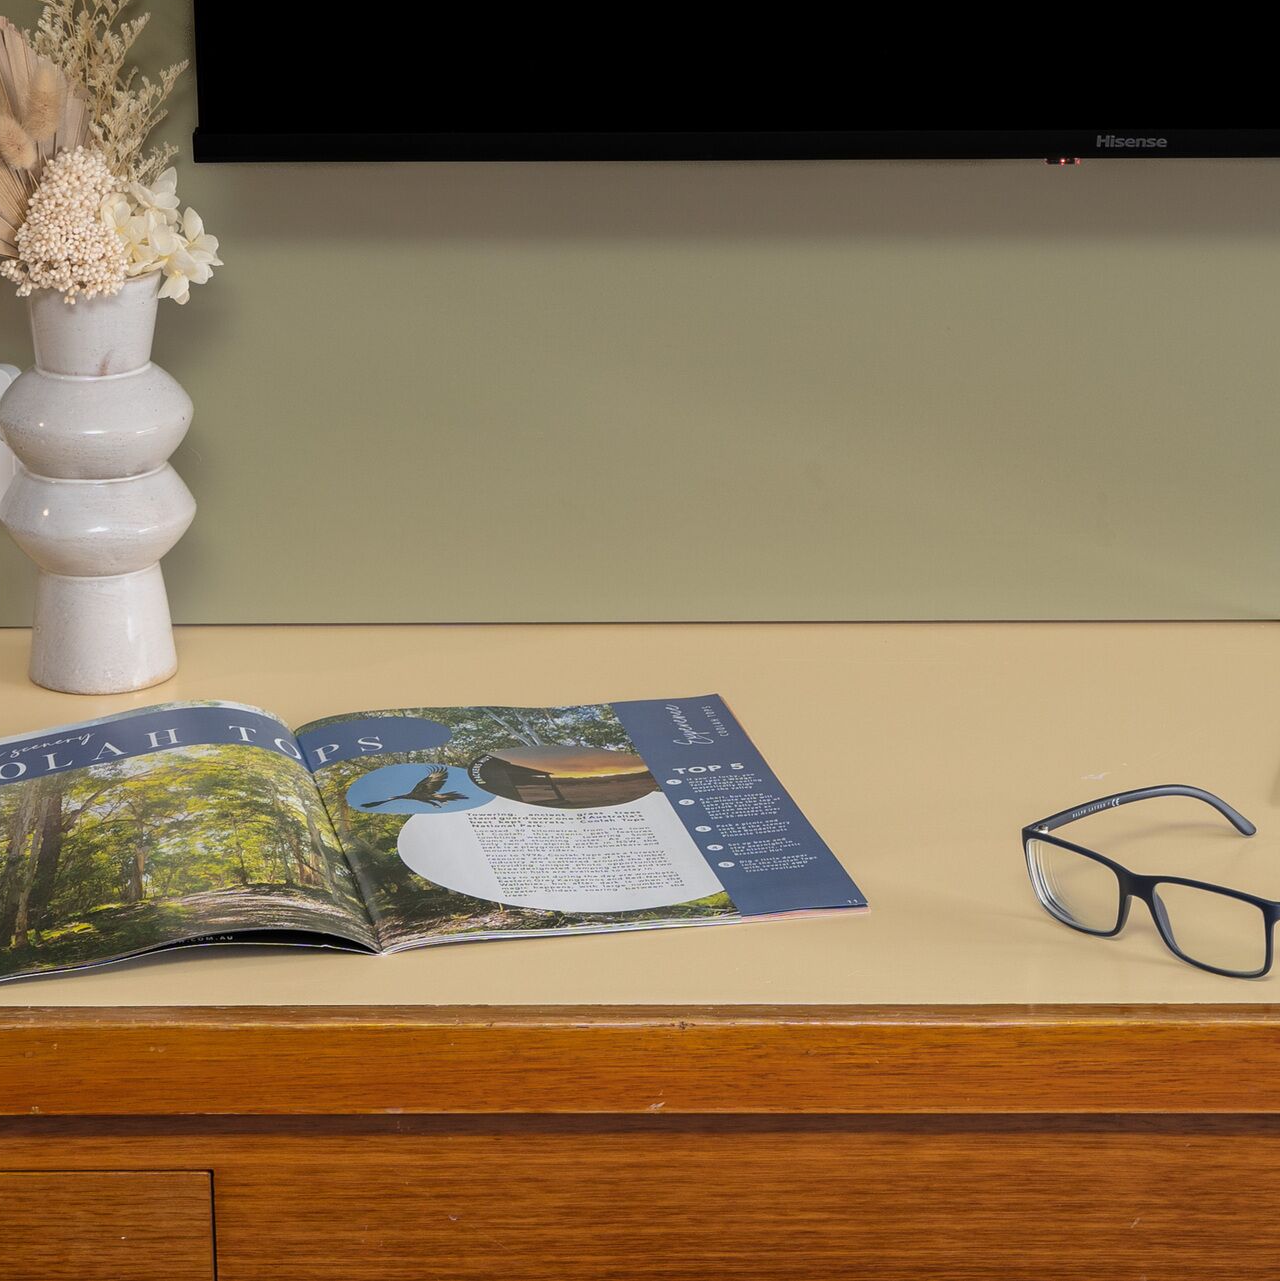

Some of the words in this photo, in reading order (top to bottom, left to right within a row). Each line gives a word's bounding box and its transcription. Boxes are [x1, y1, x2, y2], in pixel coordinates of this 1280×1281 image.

[1096, 135, 1168, 148] Hisense
[10, 732, 95, 759] scenery
[228, 725, 384, 765] TOPS
[672, 765, 722, 775] TOP
[730, 762, 744, 770] 5
